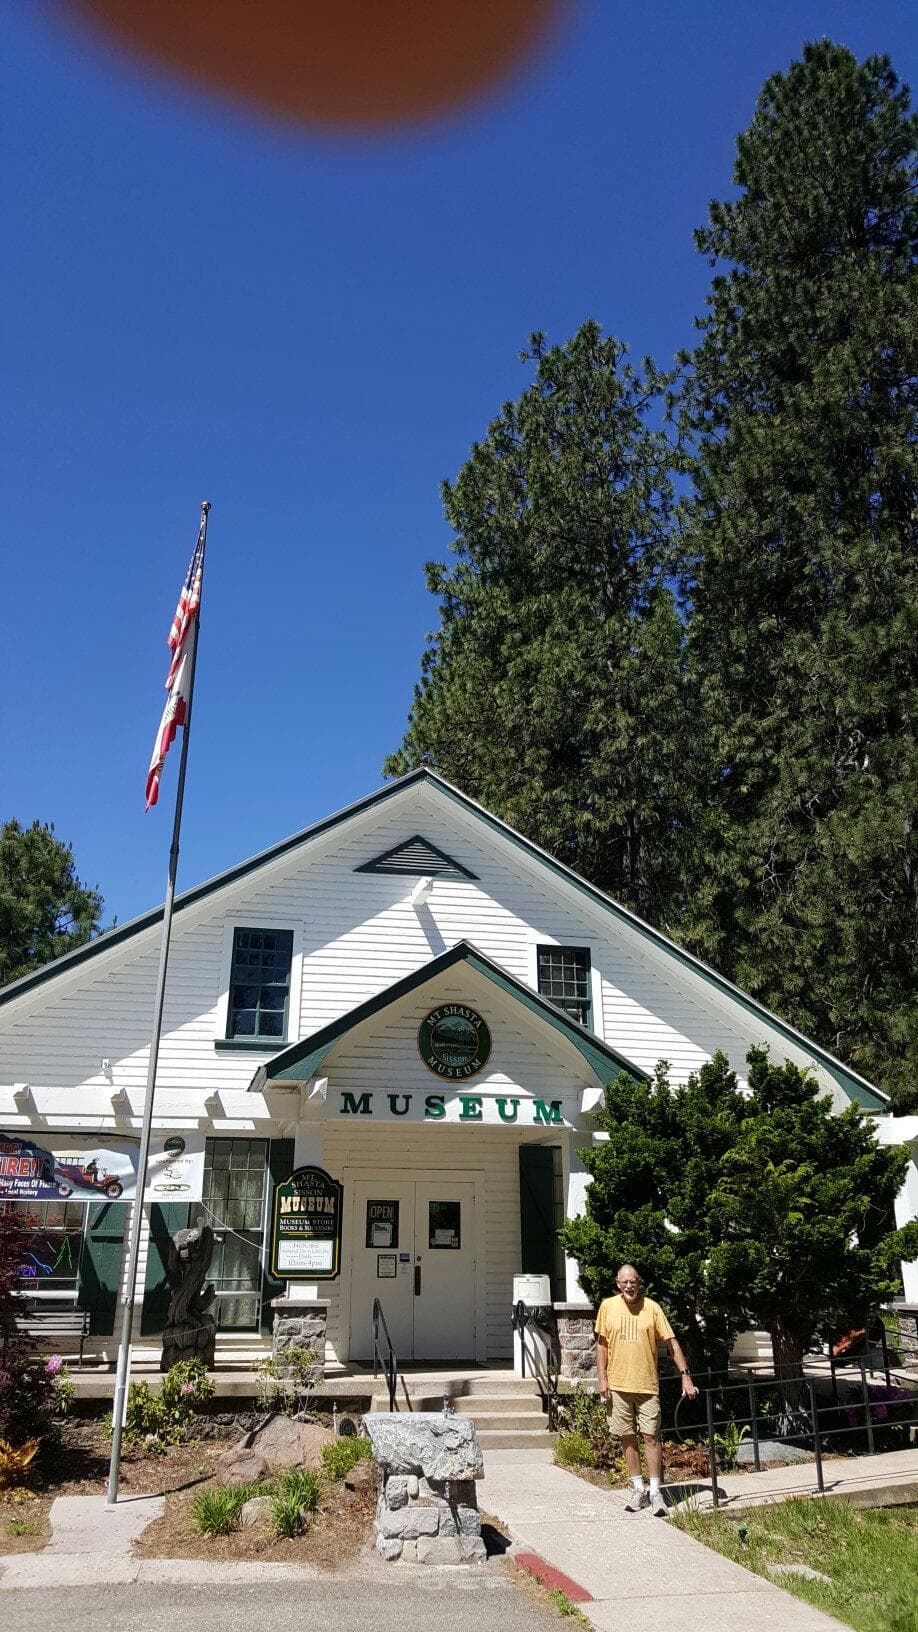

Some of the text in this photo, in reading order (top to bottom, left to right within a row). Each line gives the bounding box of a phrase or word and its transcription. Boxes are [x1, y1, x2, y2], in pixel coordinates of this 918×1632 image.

[427, 1006, 482, 1028] MT SHASTA
[427, 1056, 482, 1077] MUSEUM
[442, 1053, 467, 1063] Sisson
[339, 1092, 564, 1123] MUSEUM
[291, 1180, 325, 1189] SHASTA
[280, 1196, 336, 1214] MUSEUM
[370, 1205, 394, 1219] OPEN
